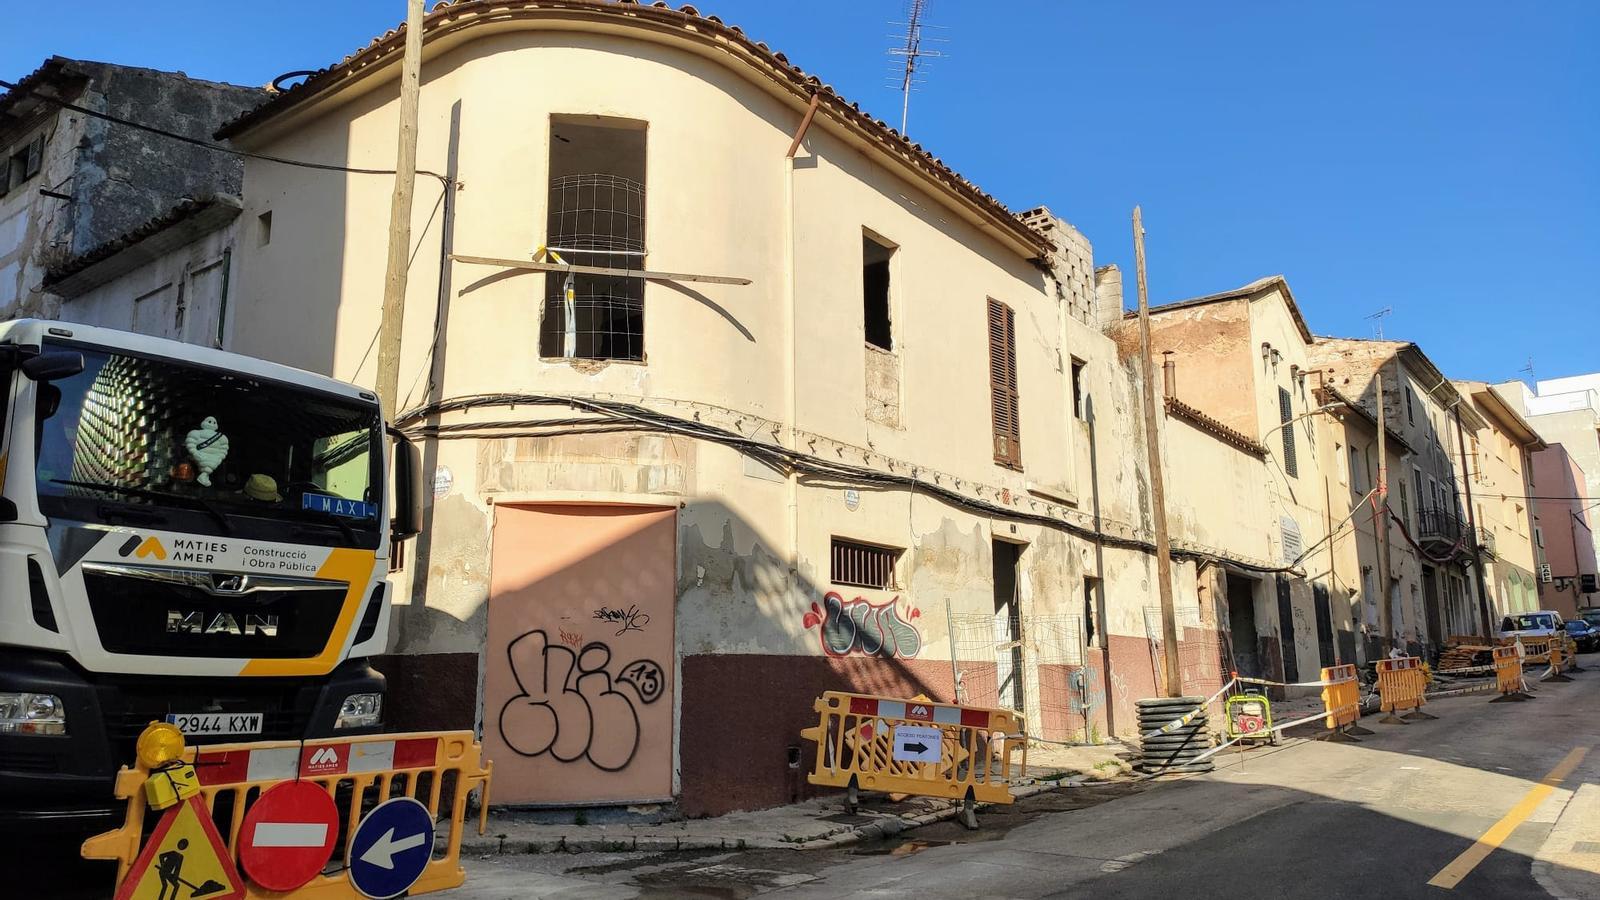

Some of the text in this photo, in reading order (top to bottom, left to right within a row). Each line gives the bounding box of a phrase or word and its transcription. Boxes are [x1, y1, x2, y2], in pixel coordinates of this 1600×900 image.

[174, 539, 228, 553] MATIES
[243, 546, 307, 560] Construcció
[173, 553, 214, 564] AMER
[242, 558, 317, 572] i Obra Pública
[166, 610, 279, 637] MAN
[178, 715, 260, 733] 2944 KXW
